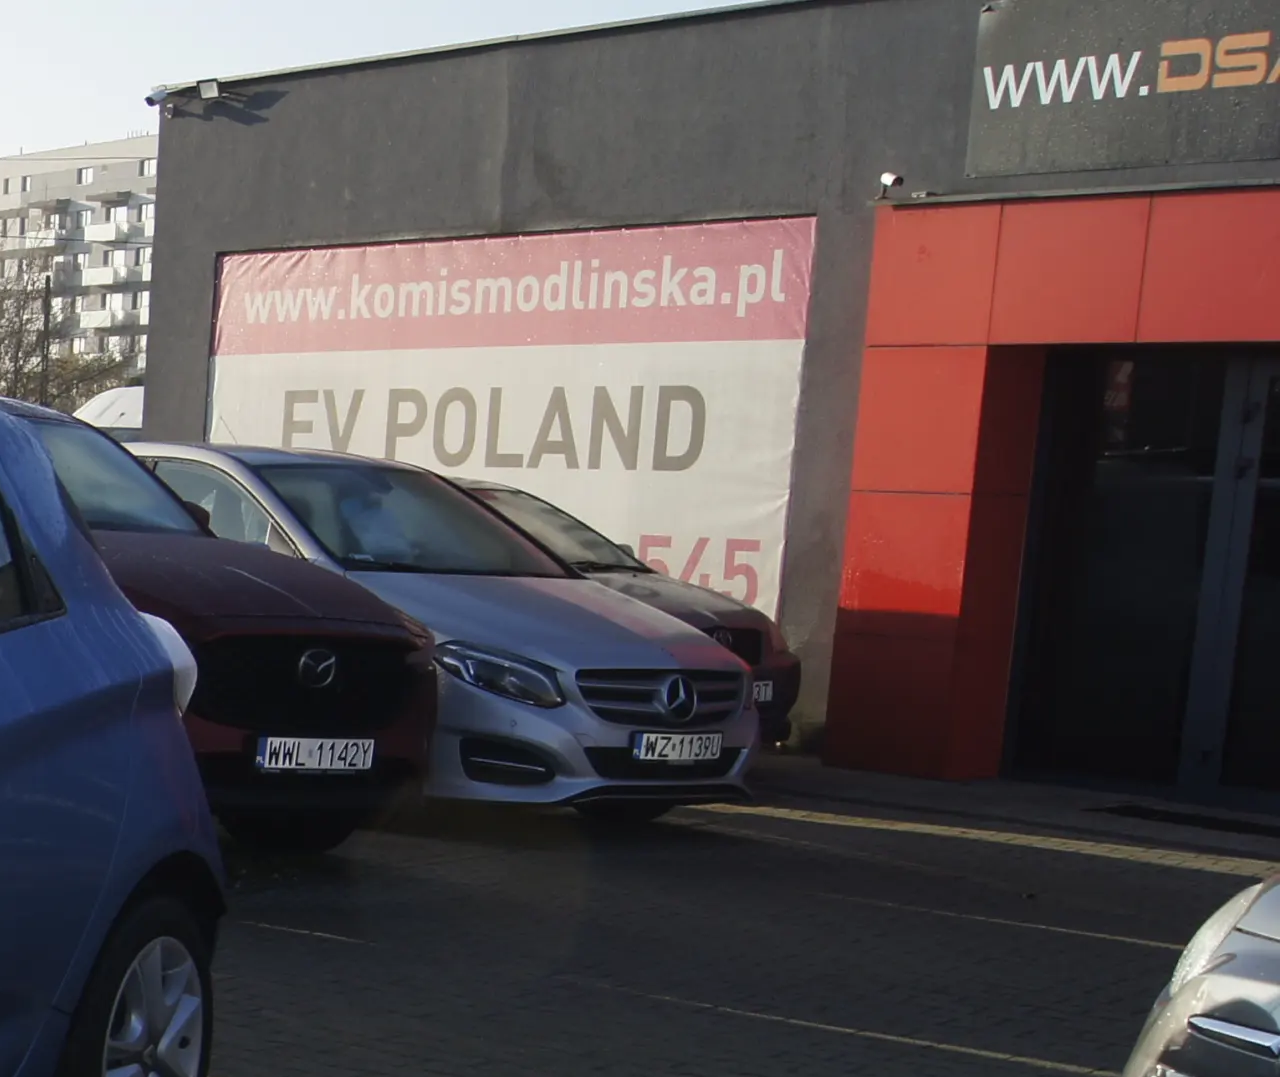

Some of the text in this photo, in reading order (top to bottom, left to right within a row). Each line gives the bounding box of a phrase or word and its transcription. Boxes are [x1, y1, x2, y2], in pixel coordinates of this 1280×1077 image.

[244, 249, 786, 326] www.komismodlinska.pl
[379, 385, 702, 471] POLAND
[268, 740, 307, 767] WWL
[316, 740, 372, 768] 1142Y
